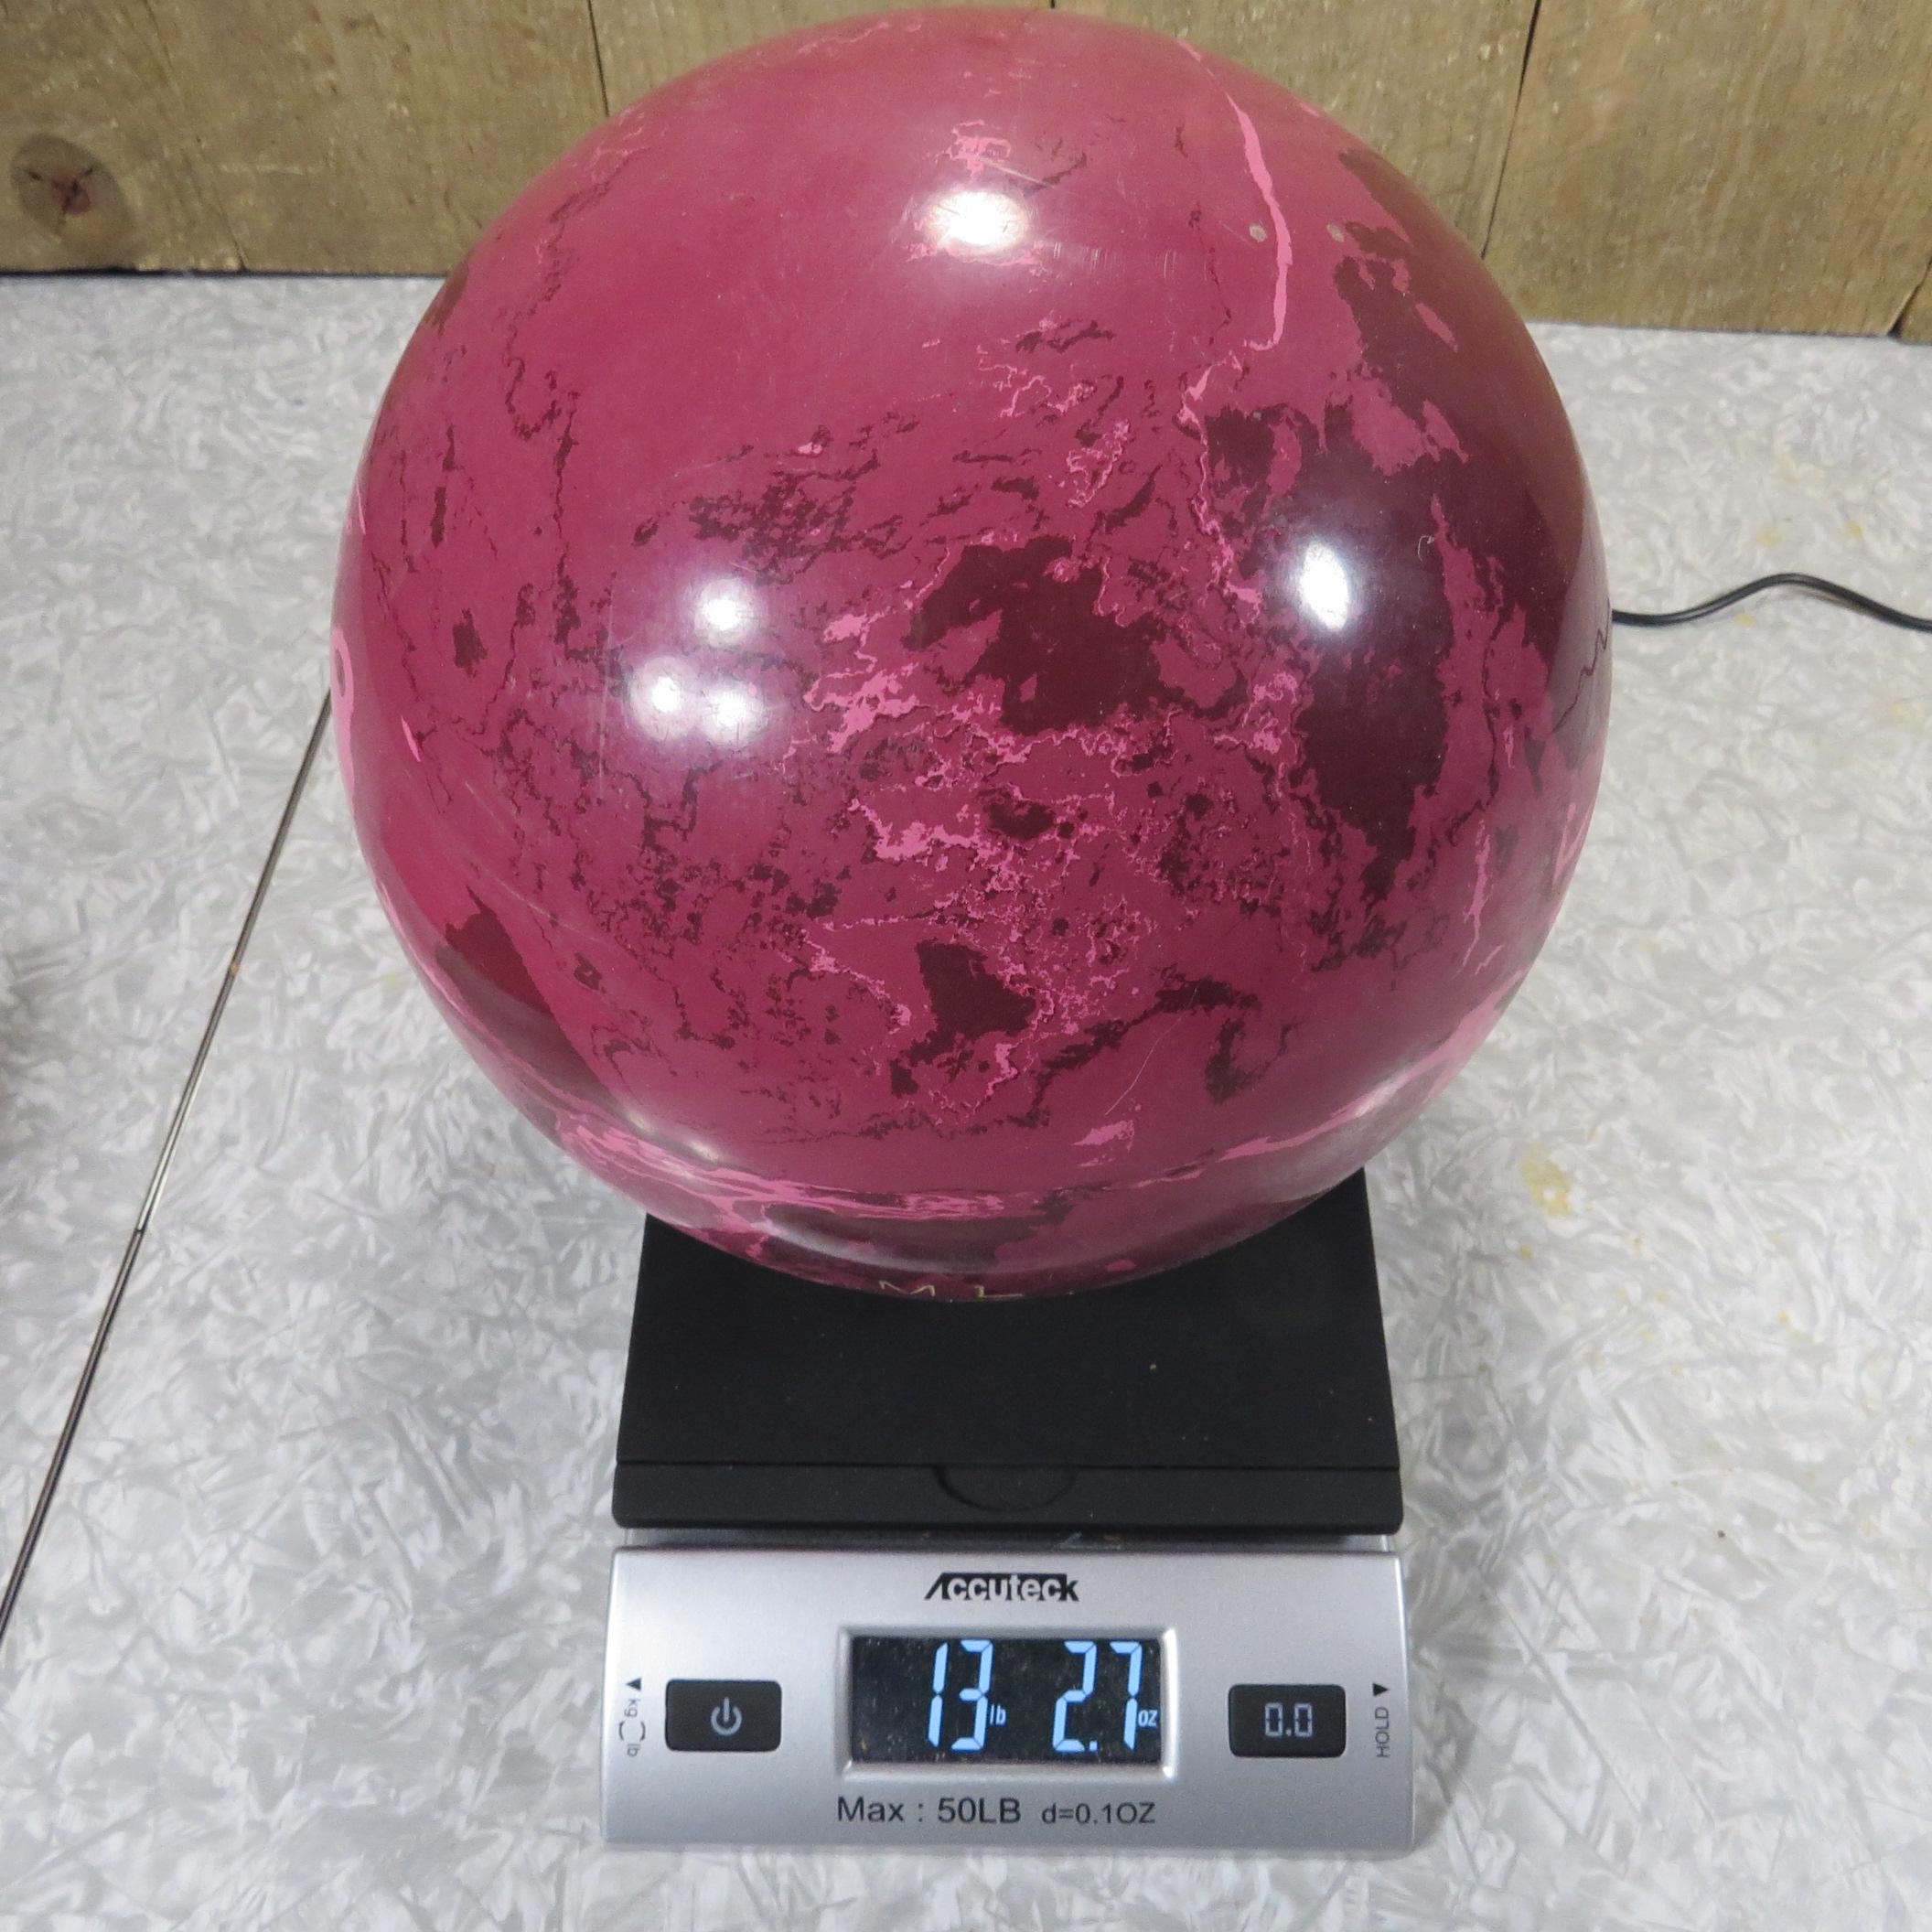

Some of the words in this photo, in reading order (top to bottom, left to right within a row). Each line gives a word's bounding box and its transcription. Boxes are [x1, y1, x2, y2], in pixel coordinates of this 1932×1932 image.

[924, 1572, 1079, 1601] Accuteck
[624, 1699, 640, 1718] kg
[928, 1639, 993, 1751] 13
[1053, 1640, 1143, 1752] 2.7
[1264, 1702, 1312, 1736] 0.0
[1374, 1707, 1390, 1757] HOLD
[627, 1743, 640, 1757] lb
[837, 1796, 905, 1822] Max
[938, 1798, 1021, 1824] 50LB
[1042, 1802, 1156, 1825] d=0.1OZ
